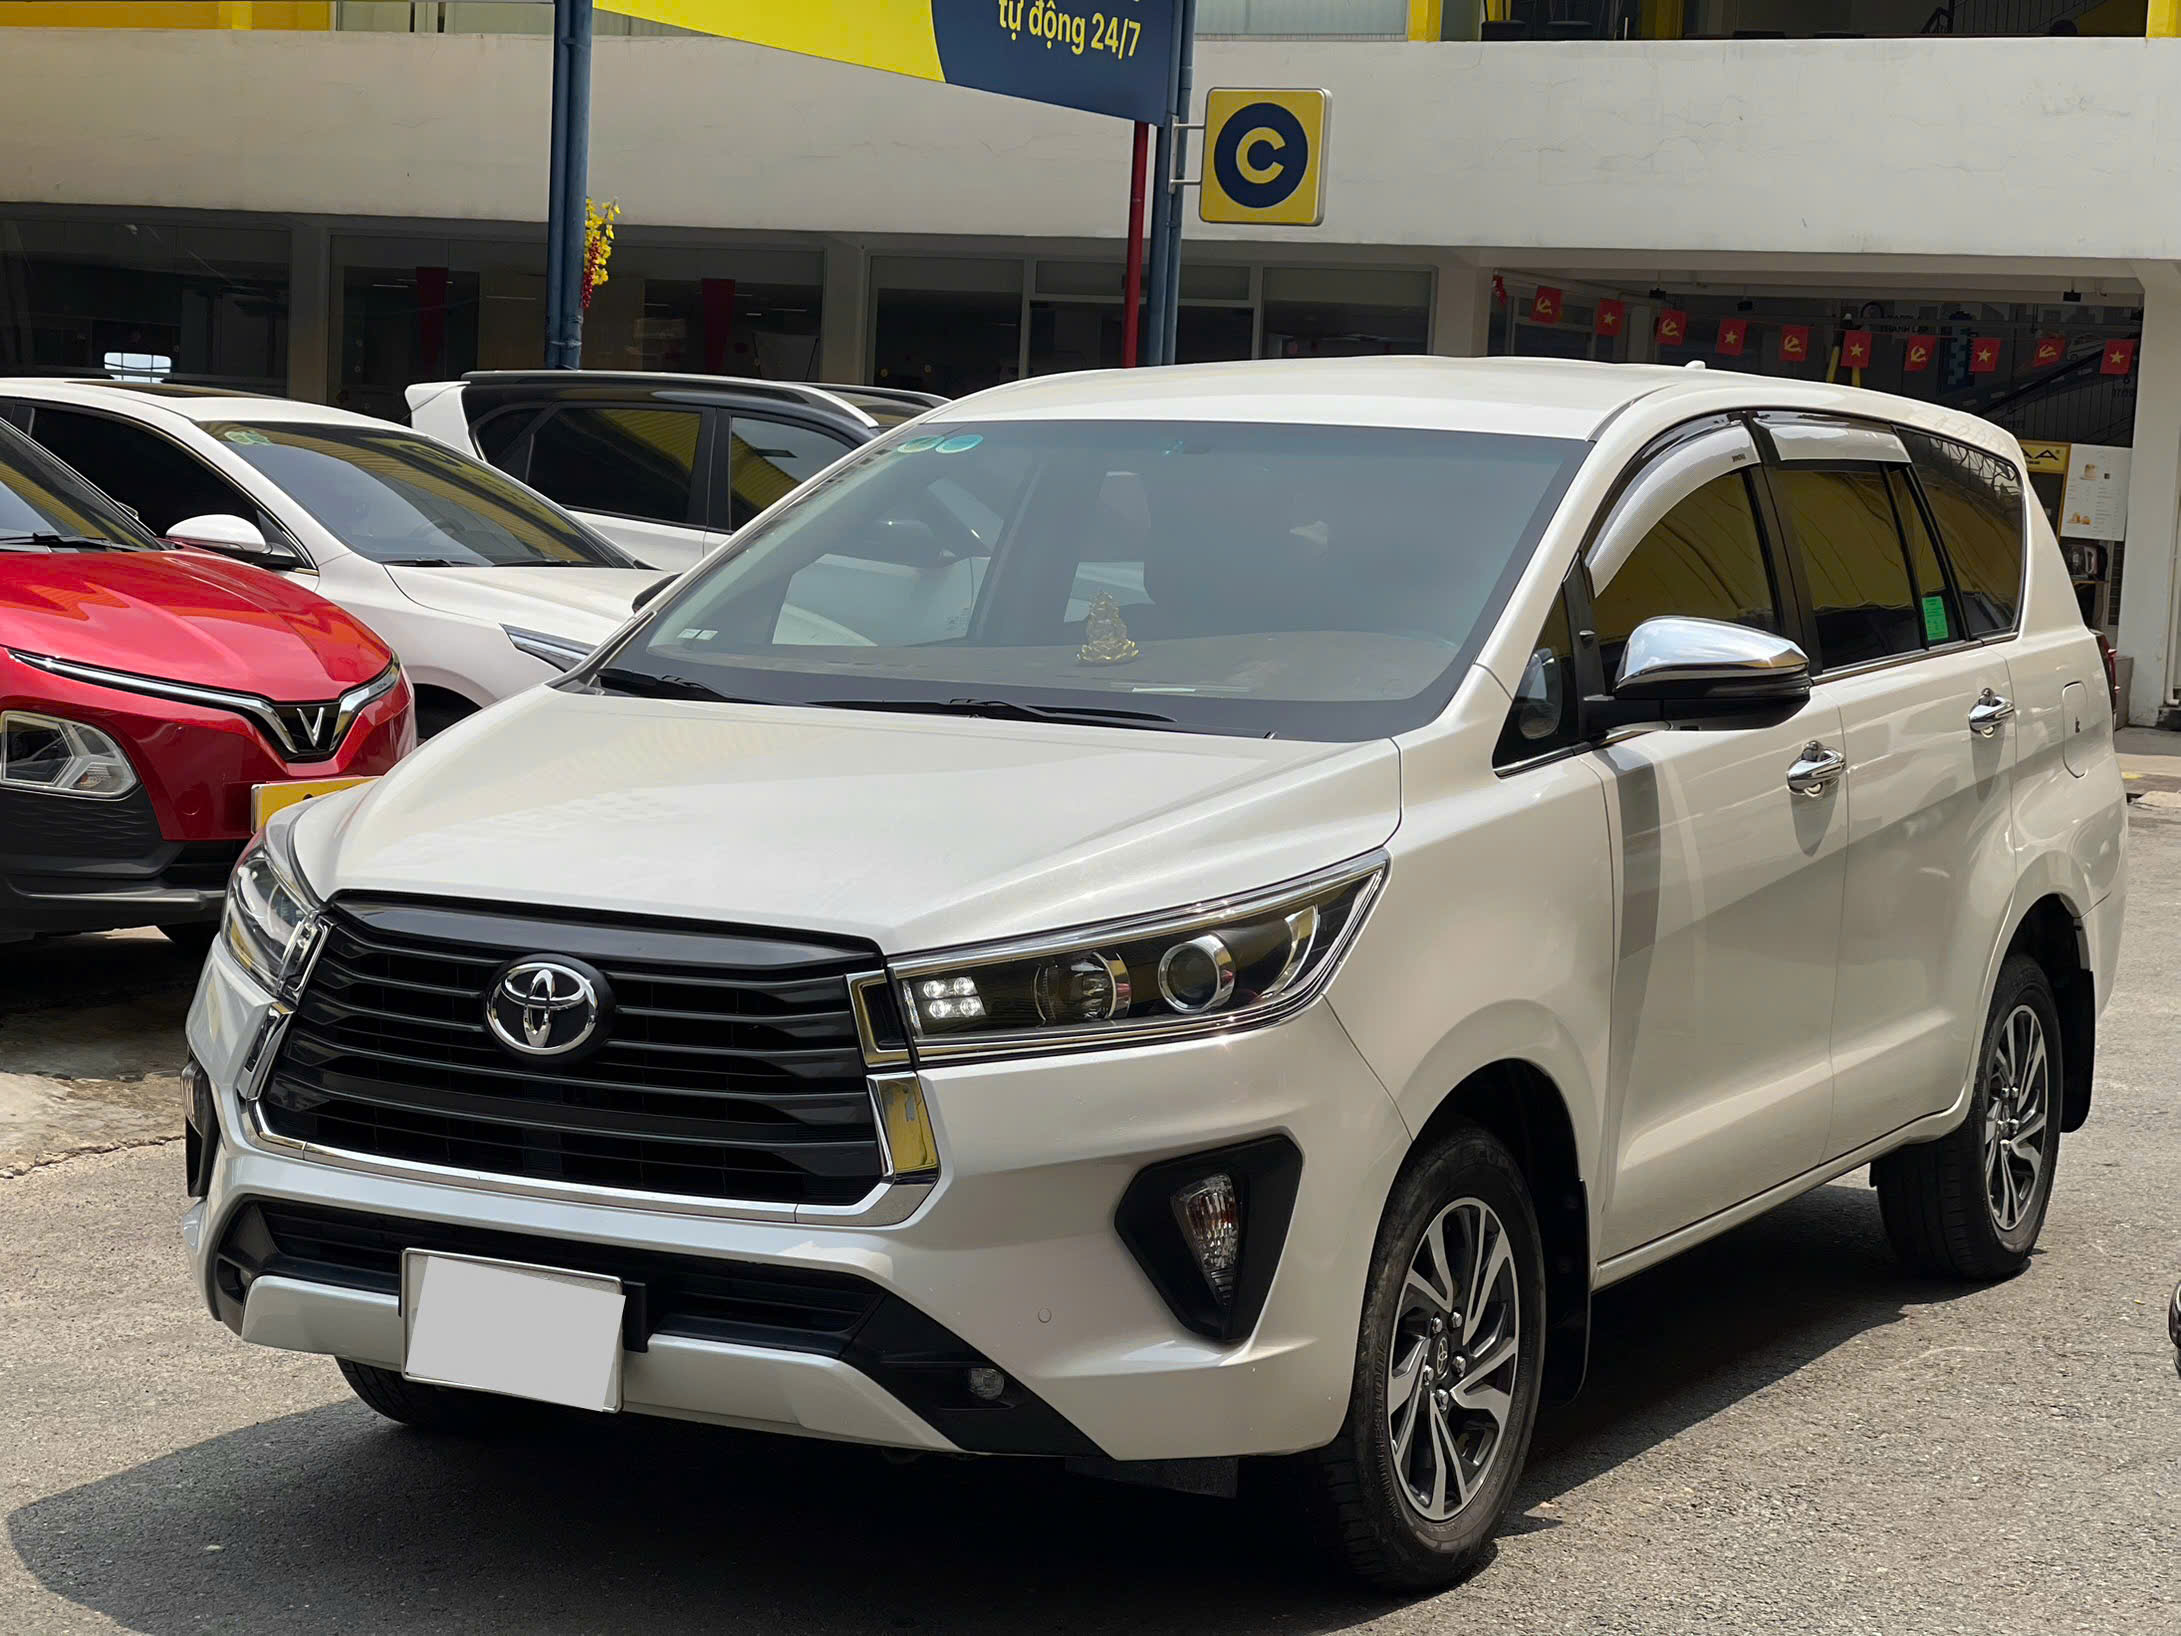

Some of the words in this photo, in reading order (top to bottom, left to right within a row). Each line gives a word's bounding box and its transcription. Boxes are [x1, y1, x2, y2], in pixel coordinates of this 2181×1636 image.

[1028, 0, 1086, 55] động
[1090, 12, 1142, 60] 24/7
[1235, 126, 1287, 185] C
